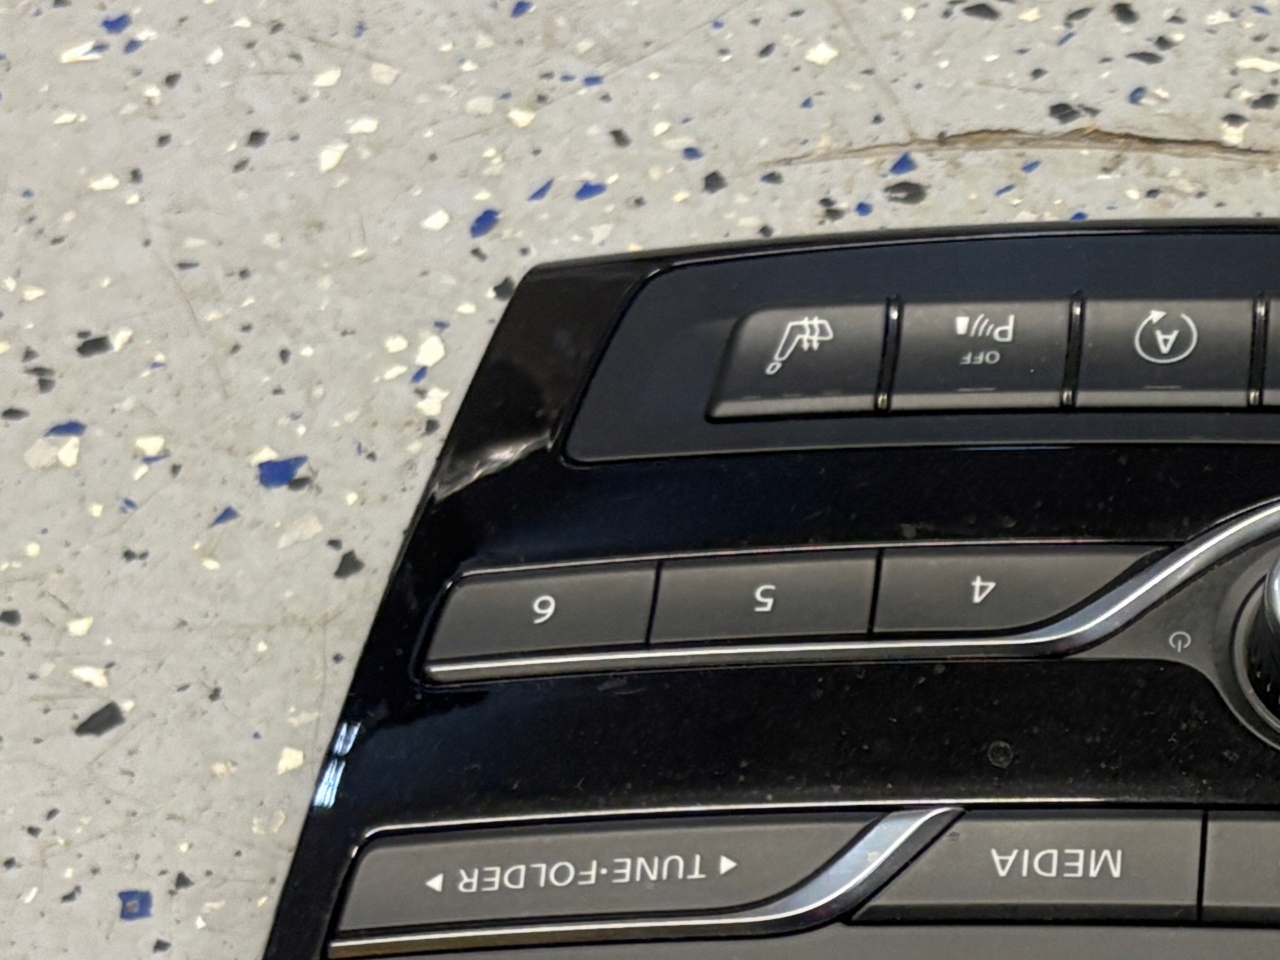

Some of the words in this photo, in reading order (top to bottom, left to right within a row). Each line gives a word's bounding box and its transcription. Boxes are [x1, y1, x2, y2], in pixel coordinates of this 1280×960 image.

[1155, 329, 1180, 354] A
[961, 350, 1001, 365] OFF
[754, 584, 776, 612] 5
[971, 575, 996, 604] 4
[532, 594, 556, 624] 6
[990, 848, 1122, 878] MEDIA
